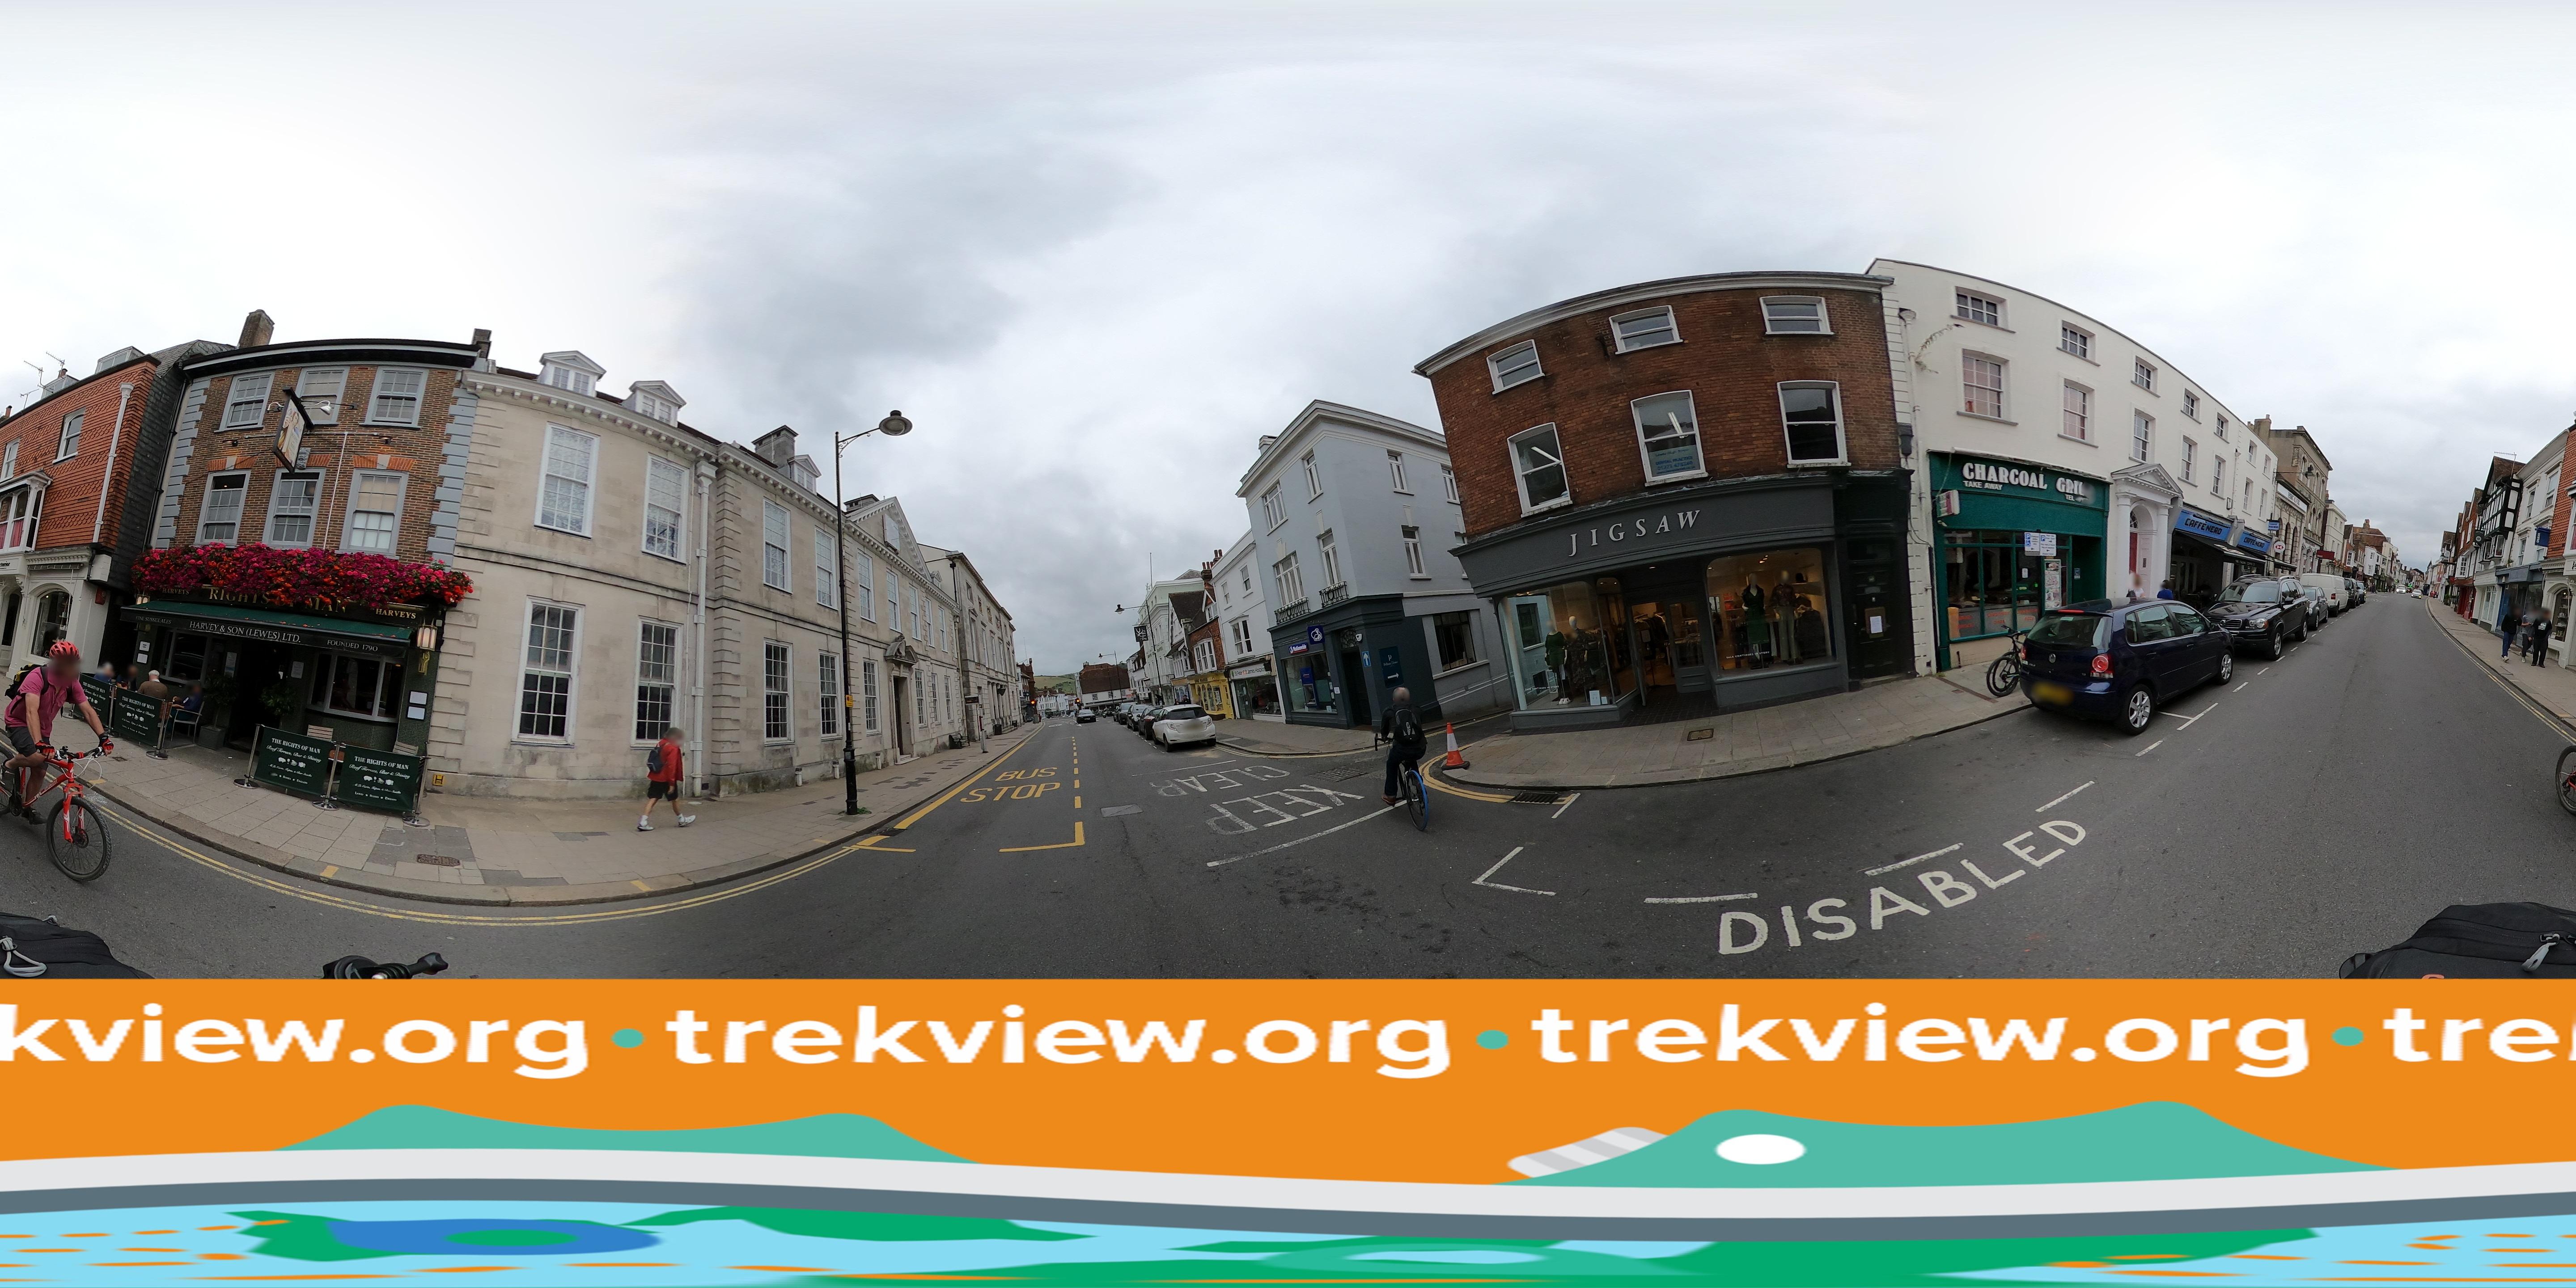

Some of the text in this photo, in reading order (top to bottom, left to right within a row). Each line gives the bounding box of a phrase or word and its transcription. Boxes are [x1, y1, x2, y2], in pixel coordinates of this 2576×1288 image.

[1962, 462, 2048, 490] CHARCOAL
[1962, 480, 1982, 488] TAKE
[1568, 510, 1700, 556] JIGSAW
[2207, 525, 2222, 535] NERO
[376, 608, 416, 619] HARVEYS
[190, 621, 219, 632] HARVEY
[227, 626, 245, 636] SON
[246, 627, 280, 641] (LEWES)
[282, 632, 301, 643] LTD.
[327, 640, 360, 649] FOUNDED
[129, 698, 142, 706] RIGHTS
[283, 740, 301, 750] RIGHTS
[307, 755, 322, 763] Dining
[366, 758, 387, 767] RIGHTS
[994, 767, 1057, 781] BUS
[1149, 765, 1290, 797] CLEAR
[960, 782, 1061, 802] STOP
[1207, 784, 1365, 835] KEEP
[1719, 819, 2087, 955] DISABLED
